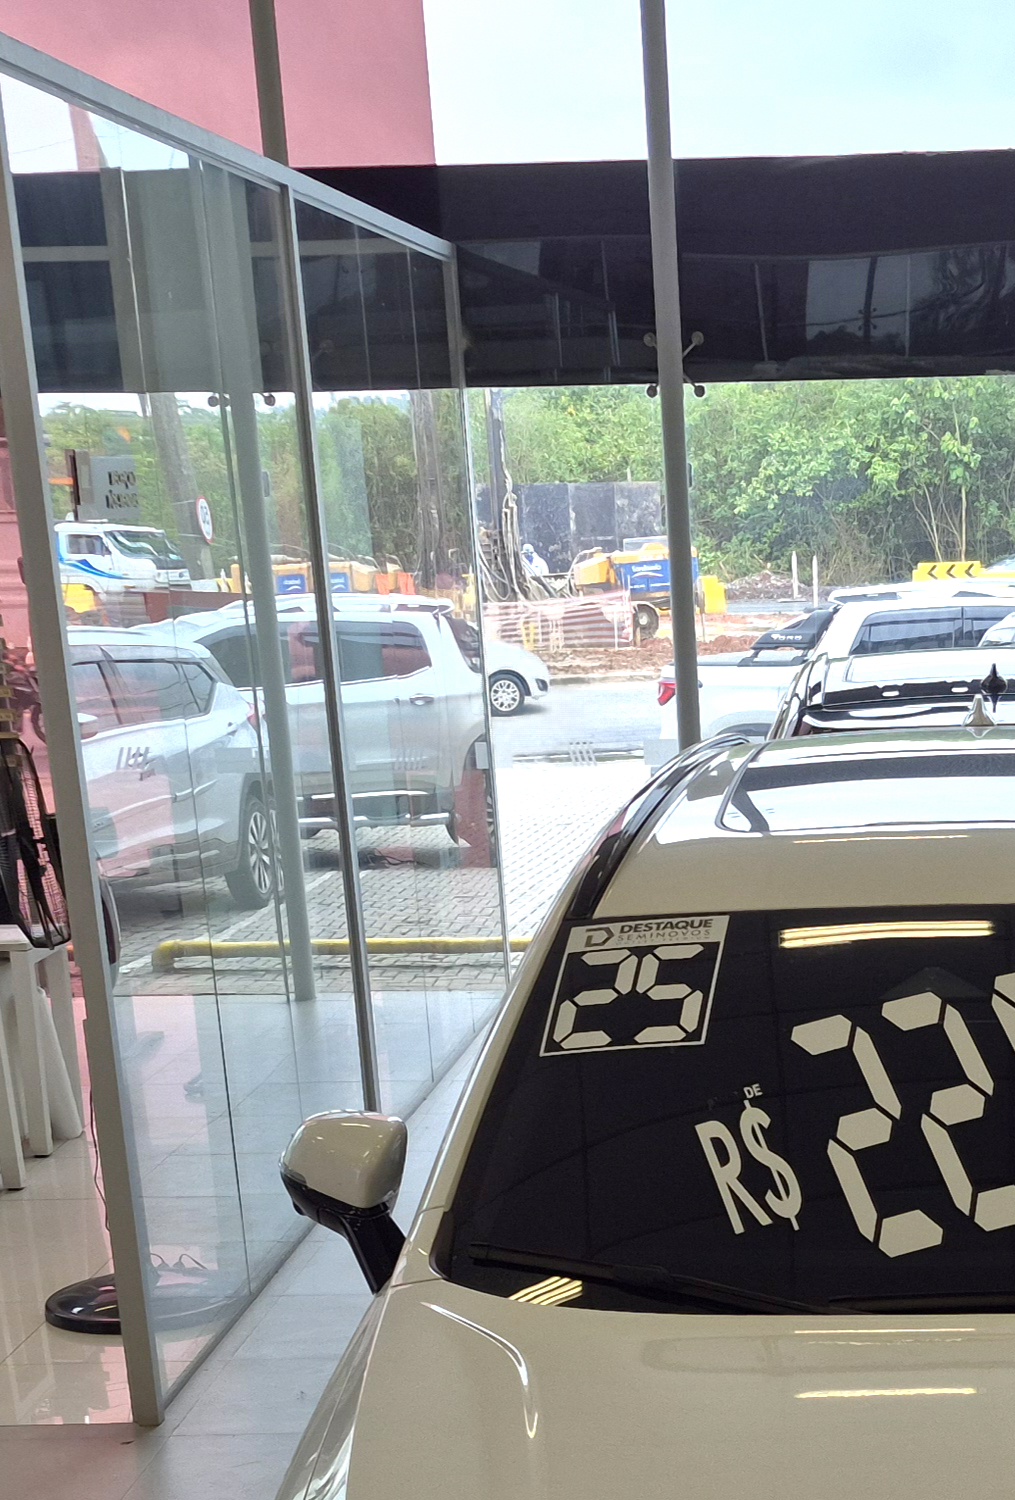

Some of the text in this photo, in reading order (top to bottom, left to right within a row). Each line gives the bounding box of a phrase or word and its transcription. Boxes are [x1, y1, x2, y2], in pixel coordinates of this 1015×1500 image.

[620, 919, 713, 934] DESTAQUE
[617, 929, 711, 941] SEMINOVOS
[553, 943, 705, 1050] 25
[743, 1083, 763, 1099] DE
[694, 1099, 803, 1235] R$
